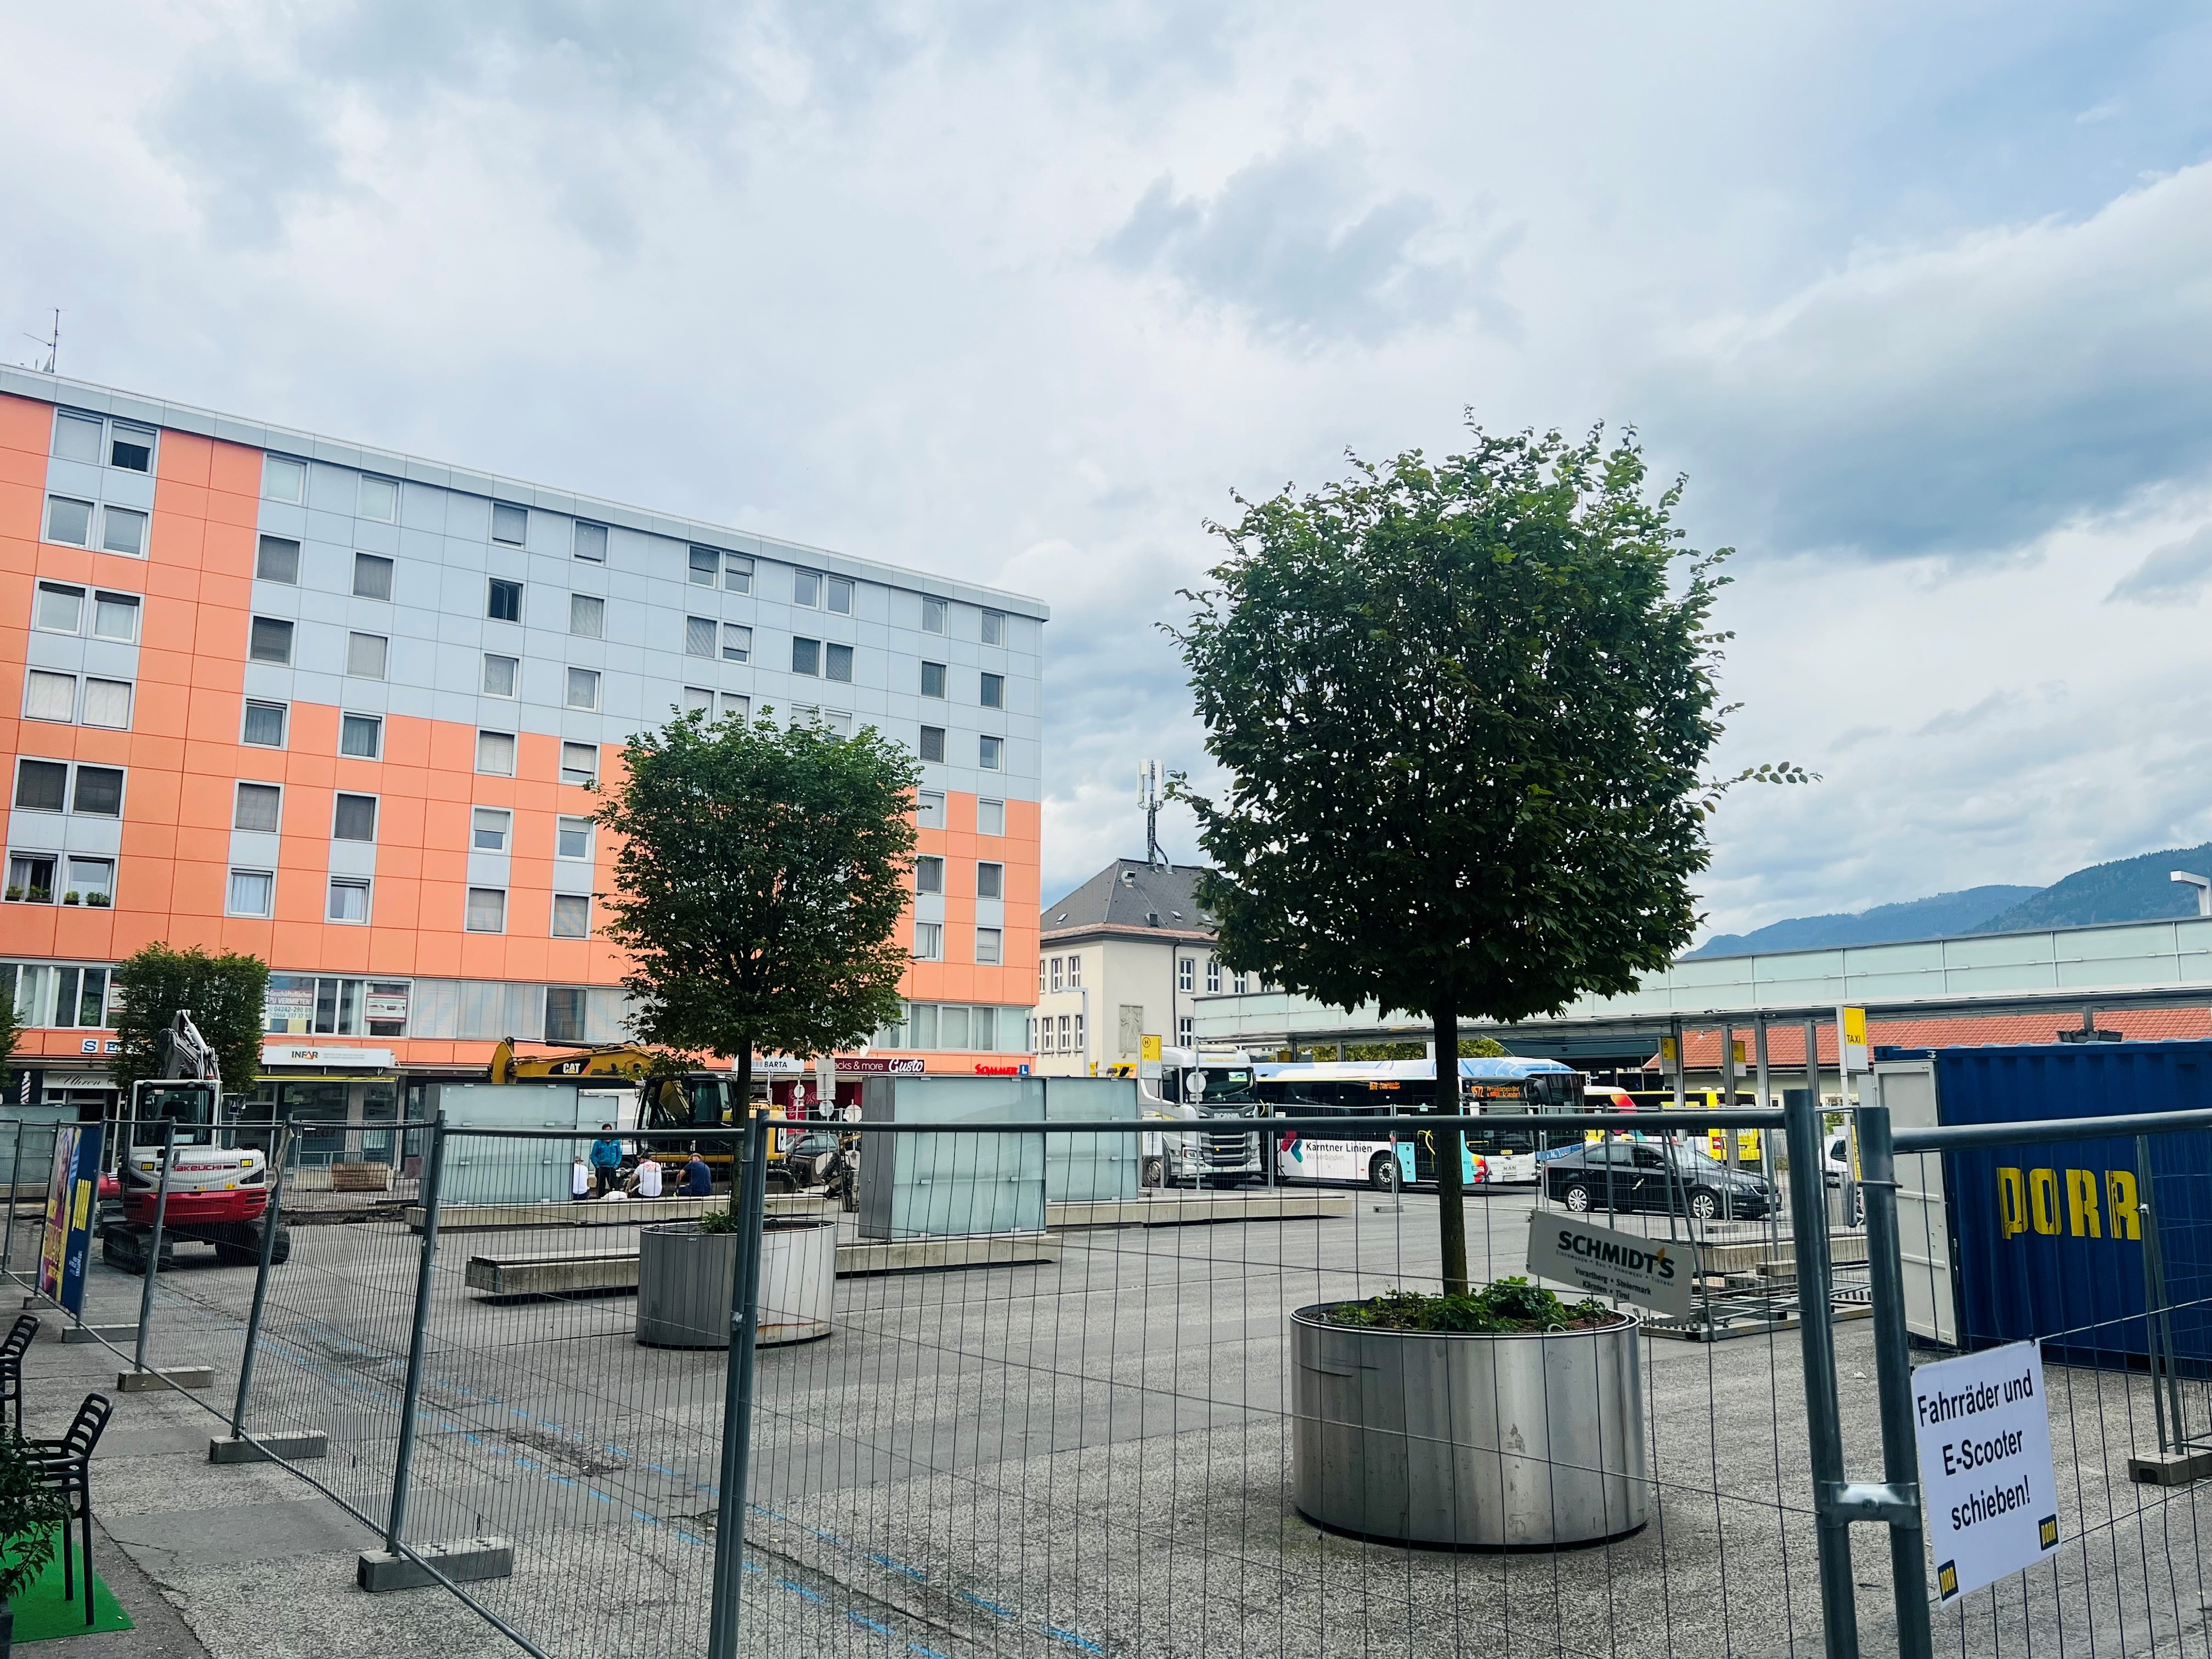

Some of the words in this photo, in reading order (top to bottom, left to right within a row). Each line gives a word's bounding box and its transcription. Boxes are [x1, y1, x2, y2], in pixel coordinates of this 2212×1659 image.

[278, 997, 313, 1006] VERMIETEN!
[1847, 1034, 1860, 1043] TAXI
[292, 1051, 318, 1059] INFAR
[563, 1063, 580, 1074] CAT
[834, 1061, 851, 1070] acks
[853, 1060, 860, 1070] &
[888, 1059, 923, 1073] Gusto
[58, 1074, 101, 1086] Uhren
[1306, 1141, 1343, 1152] Kärntner
[1346, 1142, 1372, 1153] Linien
[1996, 1167, 2141, 1240] PORR
[1575, 1266, 1608, 1284] Vorarlberg
[1616, 1278, 1651, 1296] Steiermark
[1583, 1280, 1607, 1294] Kärnten
[1616, 1290, 1630, 1300] Tirol
[1918, 1381, 1999, 1427] Fahrräder
[2005, 1369, 2033, 1403] und
[1943, 1430, 2023, 1476] E-Scooter
[1951, 1475, 2030, 1531] schieben!
[2041, 1521, 2056, 1547] PORR
[1940, 1566, 1956, 1595] PORR
